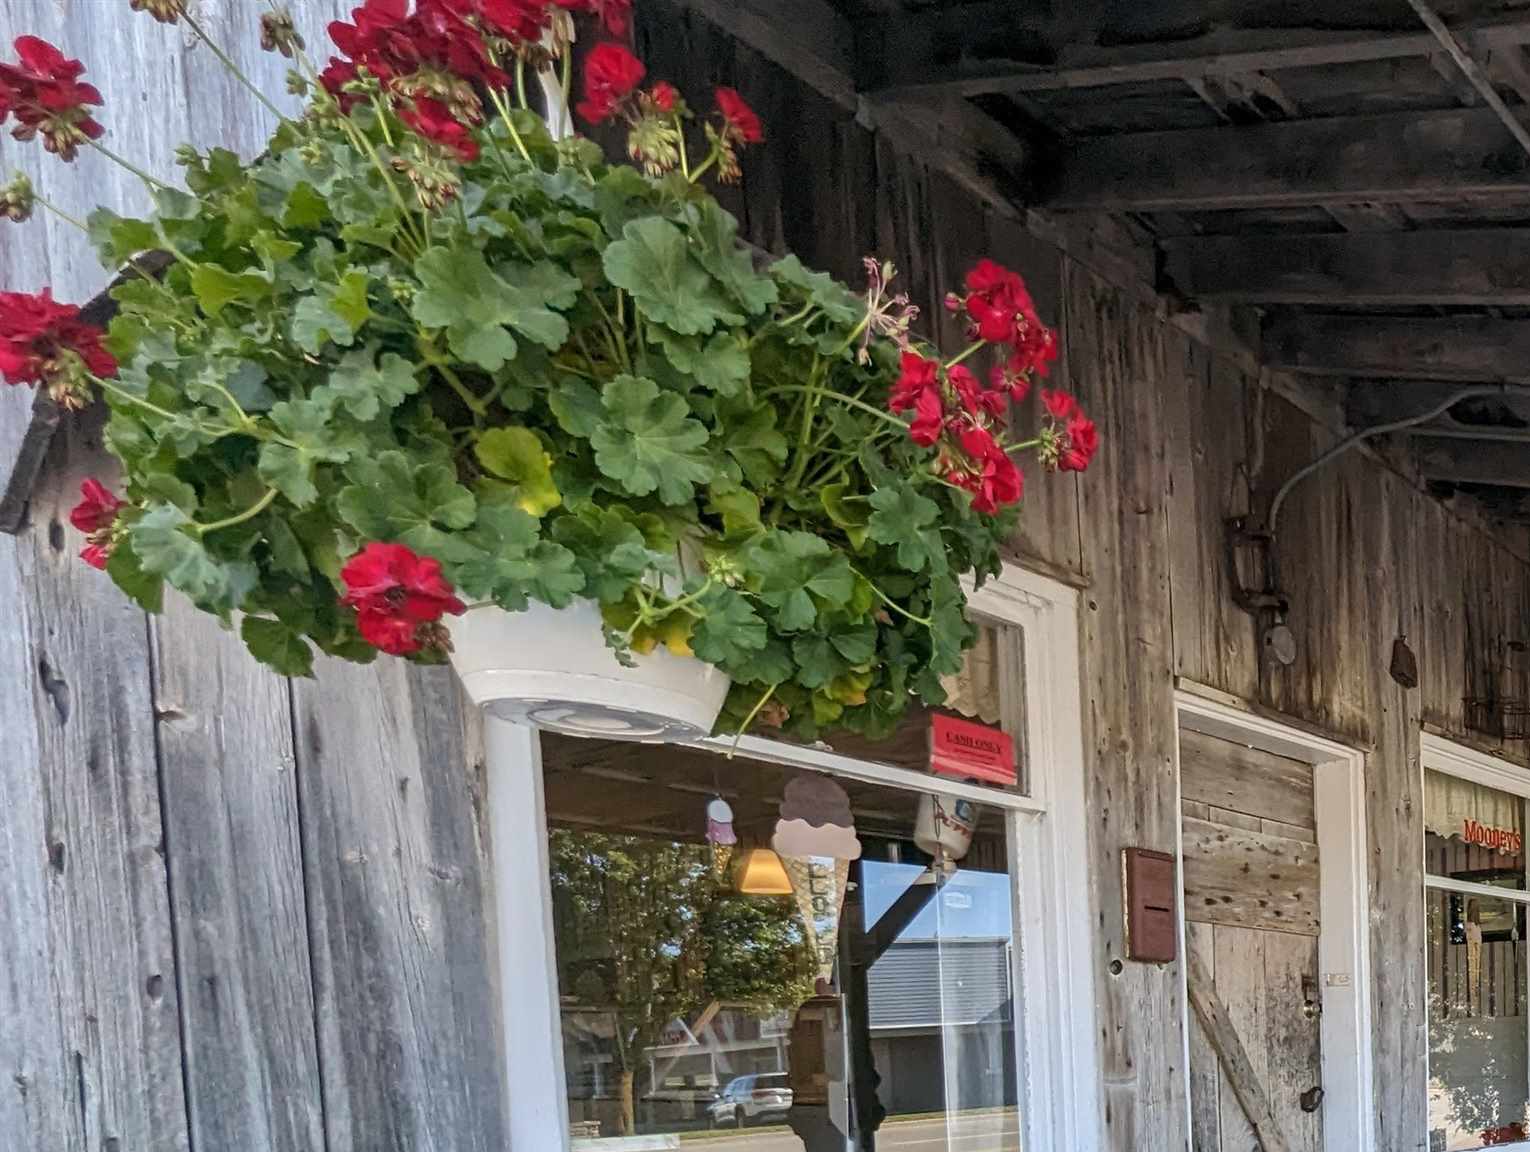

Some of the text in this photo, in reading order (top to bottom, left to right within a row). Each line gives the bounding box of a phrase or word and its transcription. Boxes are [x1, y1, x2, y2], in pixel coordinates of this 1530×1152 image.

[946, 731, 1001, 754] CASH ONLY
[1463, 819, 1521, 853] Mooney's
